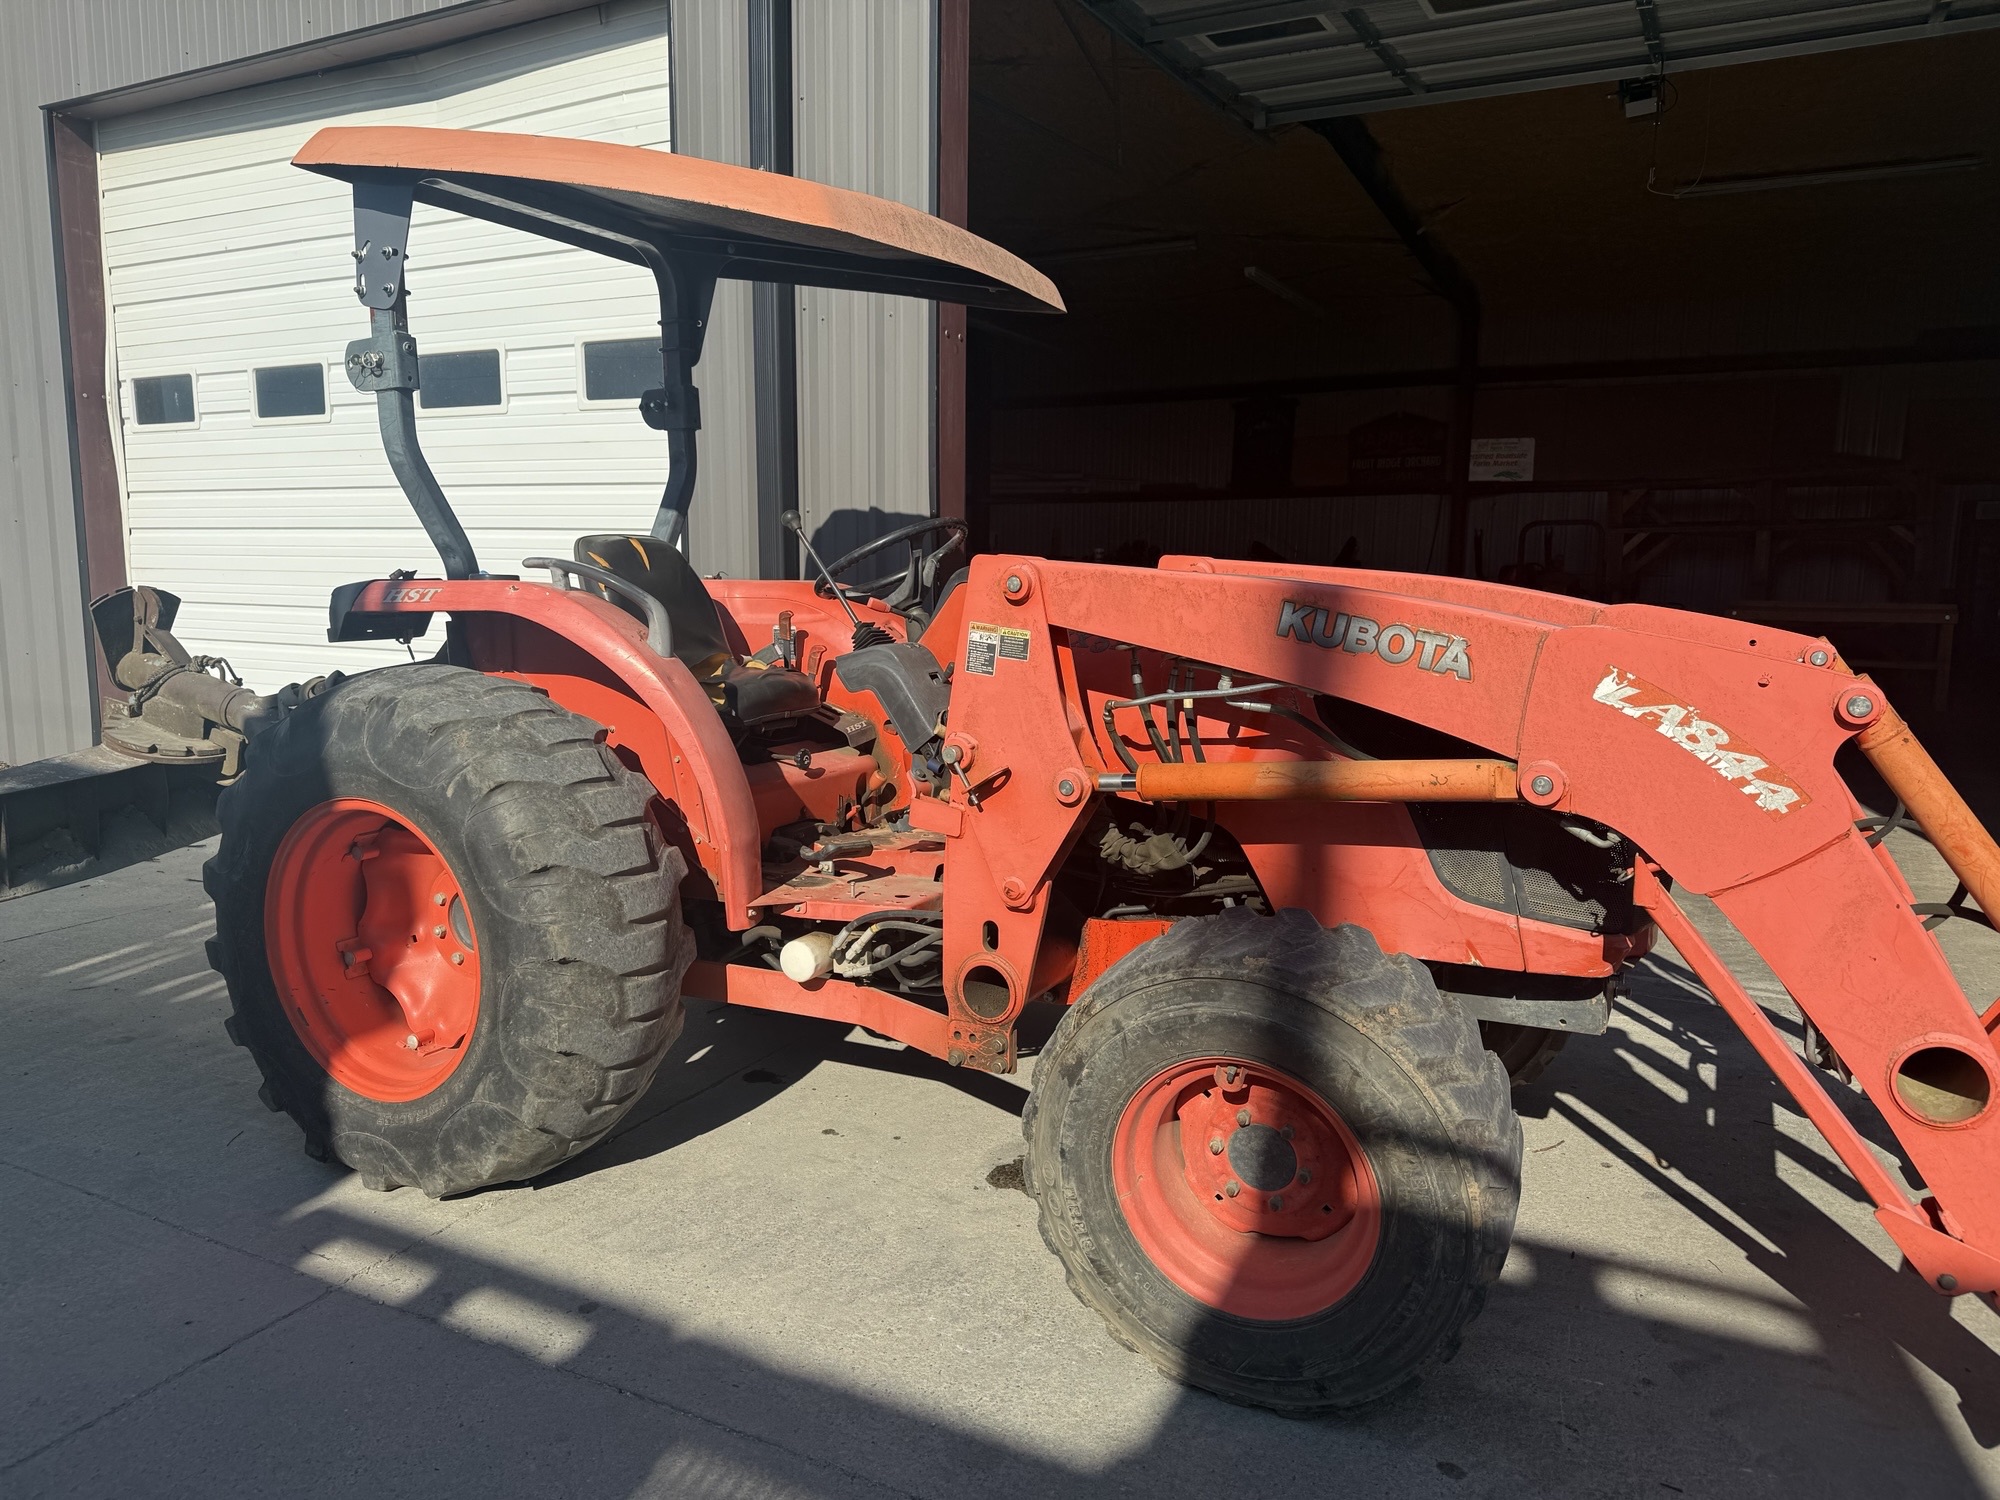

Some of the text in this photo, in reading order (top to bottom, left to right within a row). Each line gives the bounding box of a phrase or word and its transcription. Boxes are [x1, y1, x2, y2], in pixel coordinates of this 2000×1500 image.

[383, 588, 443, 603] HST
[1276, 601, 1472, 681] KUBOTA
[845, 720, 867, 734] HST
[1592, 672, 1801, 814] LA844
